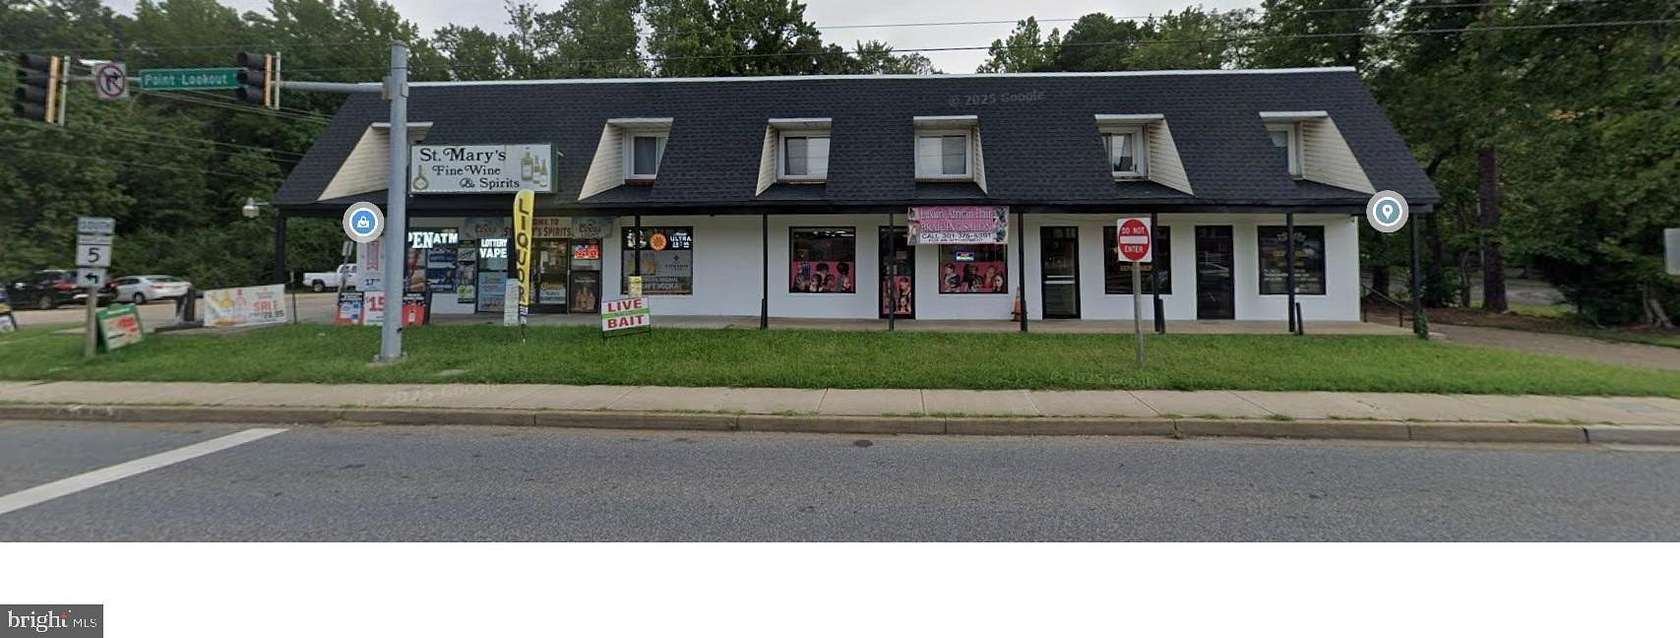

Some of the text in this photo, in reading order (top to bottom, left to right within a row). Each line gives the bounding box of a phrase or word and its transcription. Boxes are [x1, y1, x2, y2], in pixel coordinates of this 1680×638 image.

[145, 73, 228, 86] Point Lookout
[420, 148, 507, 163] St. Mary's
[432, 165, 501, 176] Fine Wine
[459, 178, 520, 190] & Spirits
[433, 233, 458, 244] ATM
[481, 239, 508, 247] LOTTERY
[88, 247, 101, 263] 5
[480, 248, 508, 258] VAPE
[607, 299, 642, 313] LIVE
[607, 315, 644, 329] BAIT
